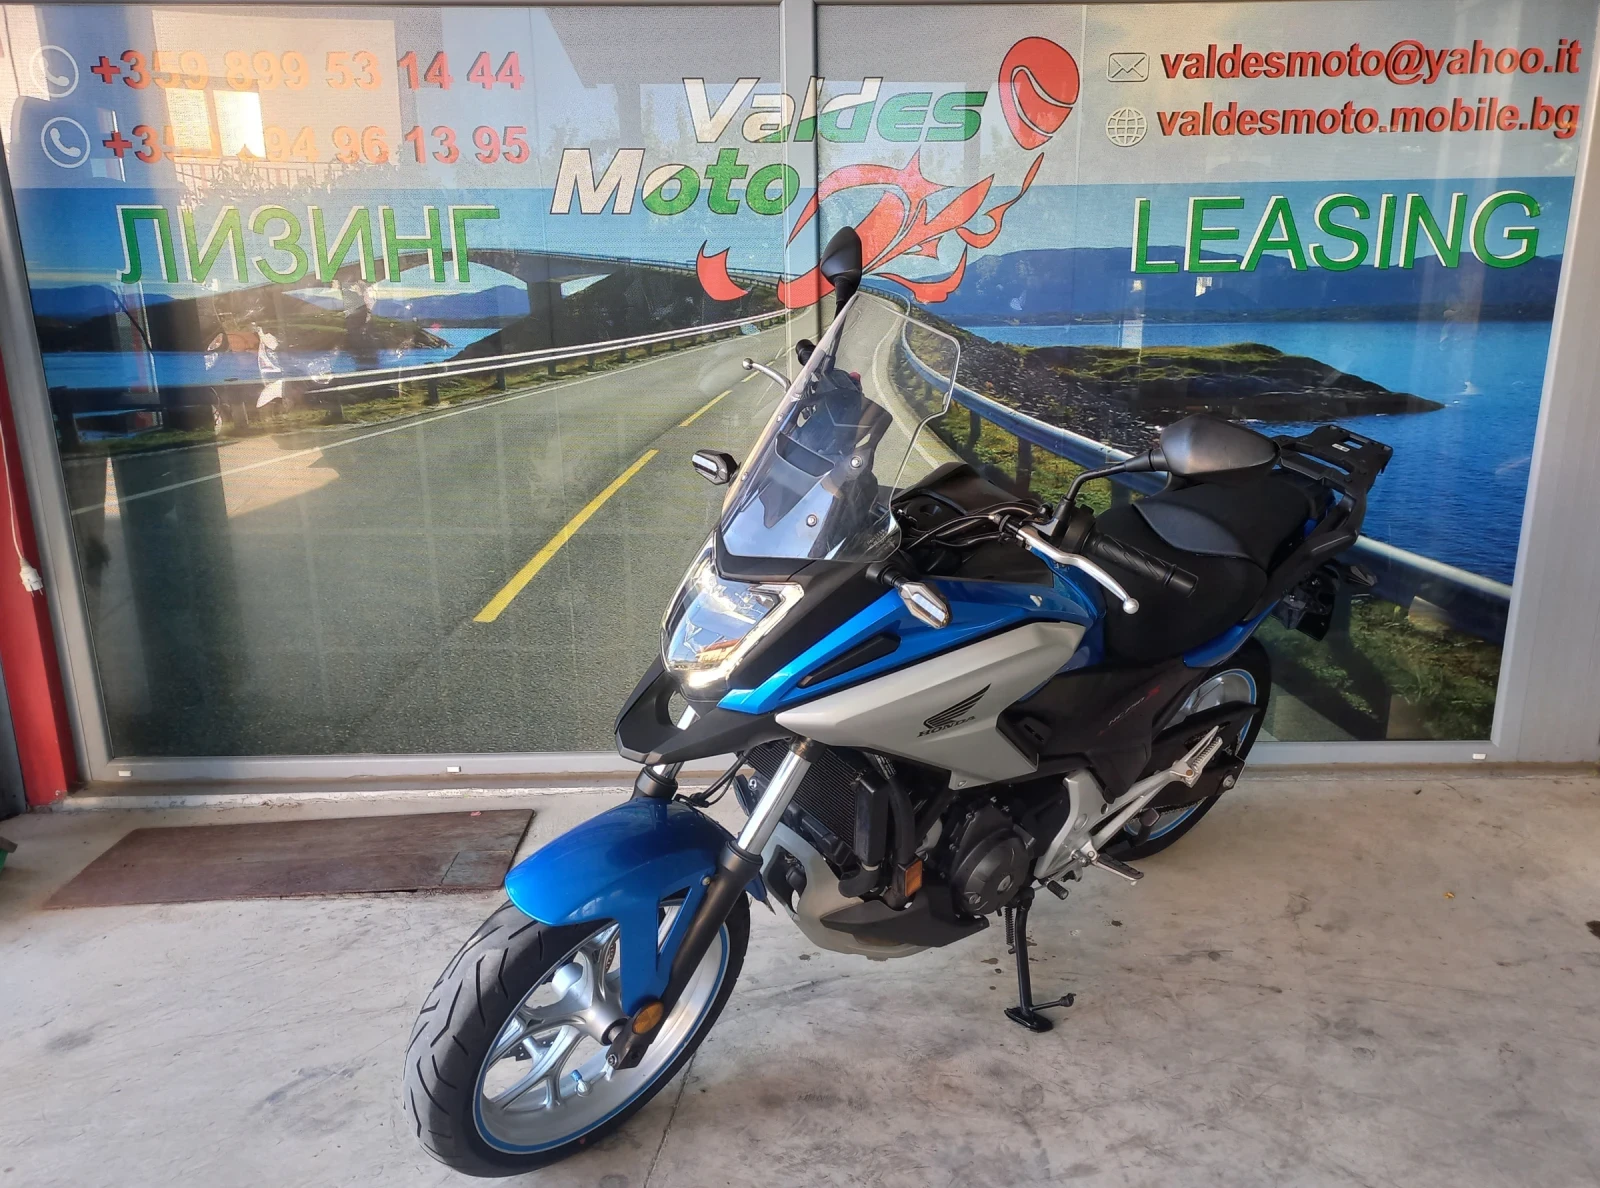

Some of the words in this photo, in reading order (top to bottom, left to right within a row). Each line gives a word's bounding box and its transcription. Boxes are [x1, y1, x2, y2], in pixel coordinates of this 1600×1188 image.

[90, 49, 209, 91] +359
[224, 50, 310, 91] 899
[324, 50, 382, 91] 53
[397, 50, 455, 91] 14
[466, 51, 525, 91] 44
[1160, 38, 1582, 85] valdesmoto@yahoo.it
[682, 76, 988, 144] Valdes
[1156, 96, 1580, 138] valdesmoto.mobile.bg
[332, 125, 390, 165] 96
[404, 125, 460, 165] 13
[472, 125, 531, 165] 95
[549, 147, 801, 216] Moto
[115, 203, 501, 284] ЛИЗИНГ
[1130, 190, 1541, 275] LEASING
[916, 714, 976, 739] HONDA
